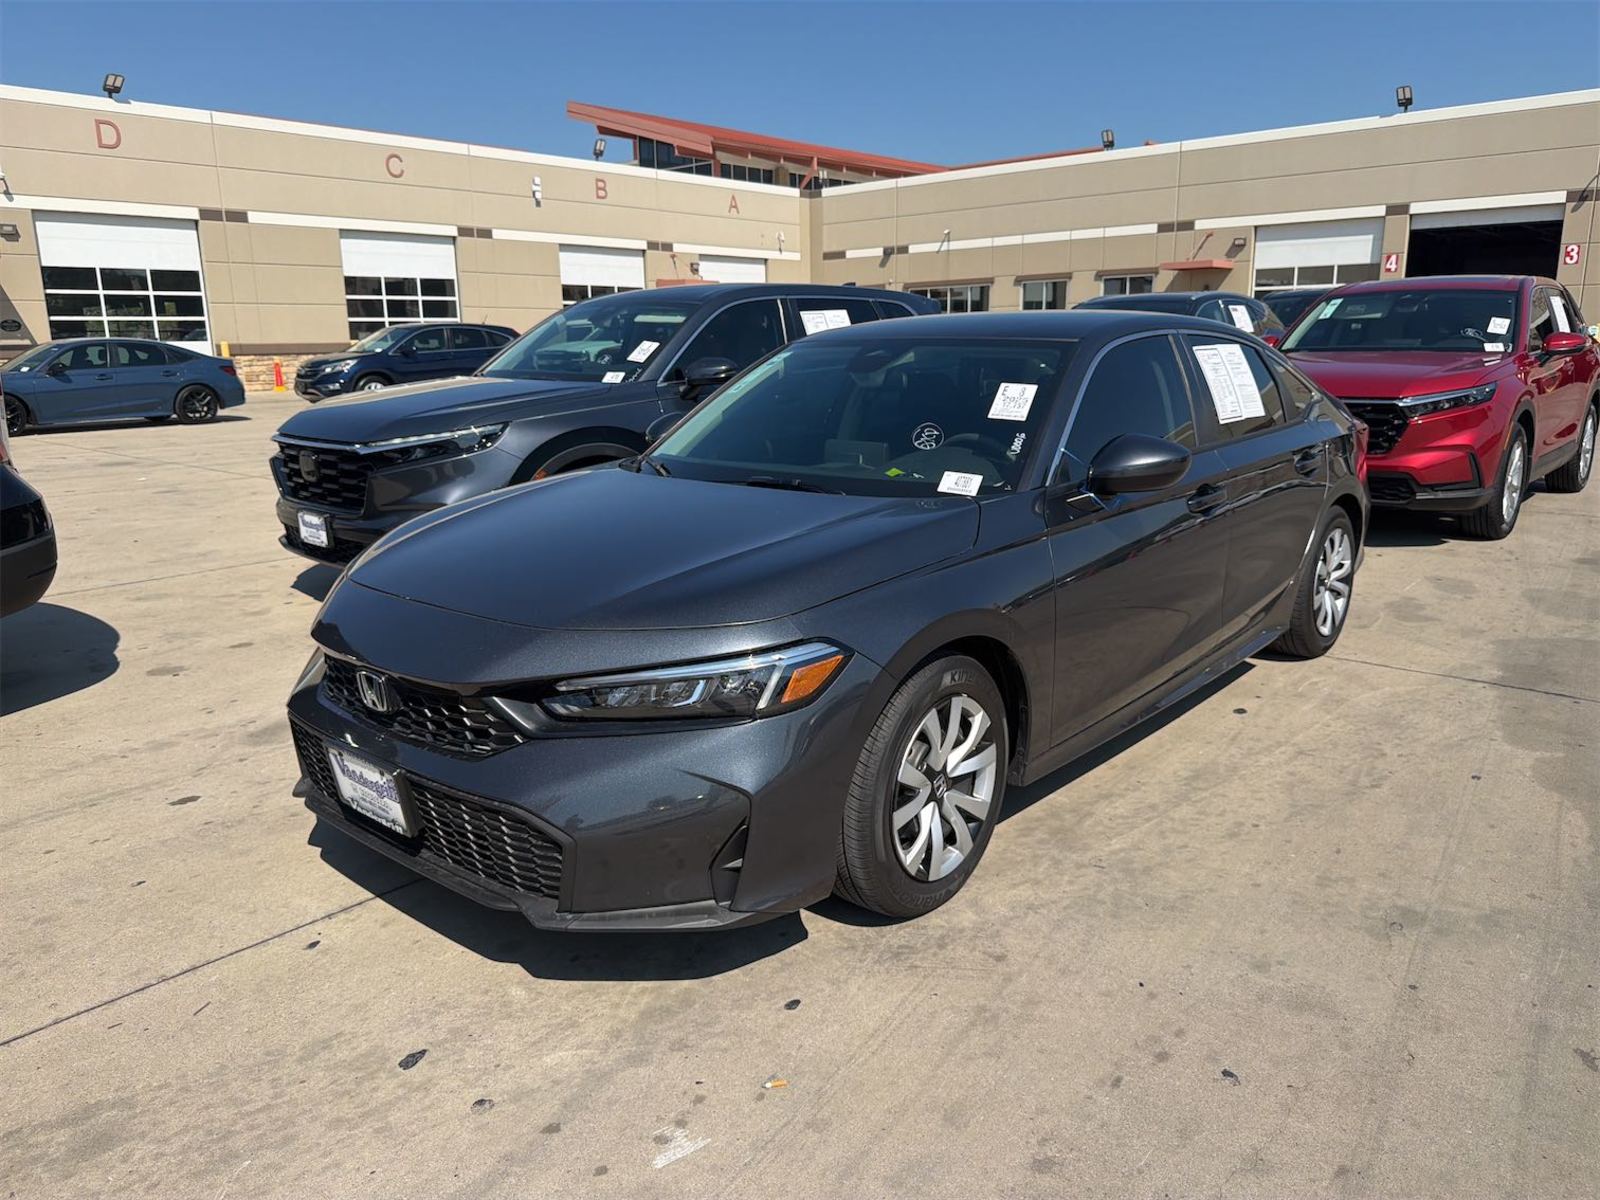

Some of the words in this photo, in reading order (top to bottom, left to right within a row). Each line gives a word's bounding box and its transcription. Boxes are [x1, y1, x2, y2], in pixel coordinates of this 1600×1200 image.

[94, 118, 122, 150] D
[385, 153, 405, 179] C
[594, 178, 608, 200] B
[728, 194, 740, 215] A
[1385, 254, 1398, 272] 4
[1565, 244, 1580, 264] 3
